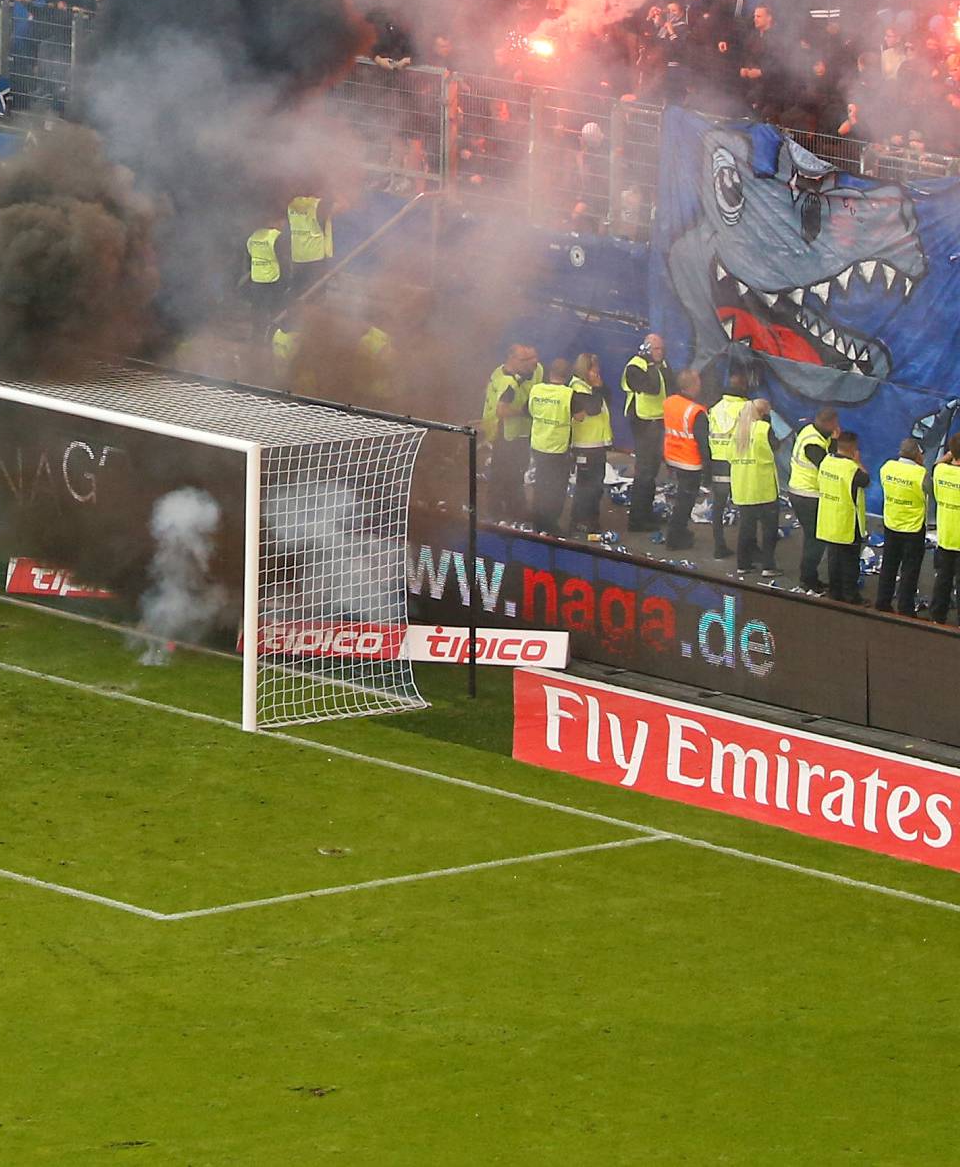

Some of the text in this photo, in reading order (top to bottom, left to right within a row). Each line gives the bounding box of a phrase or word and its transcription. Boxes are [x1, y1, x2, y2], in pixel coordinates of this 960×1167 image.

[426, 625, 548, 666] tipico
[542, 683, 953, 849] Fly Emirates
